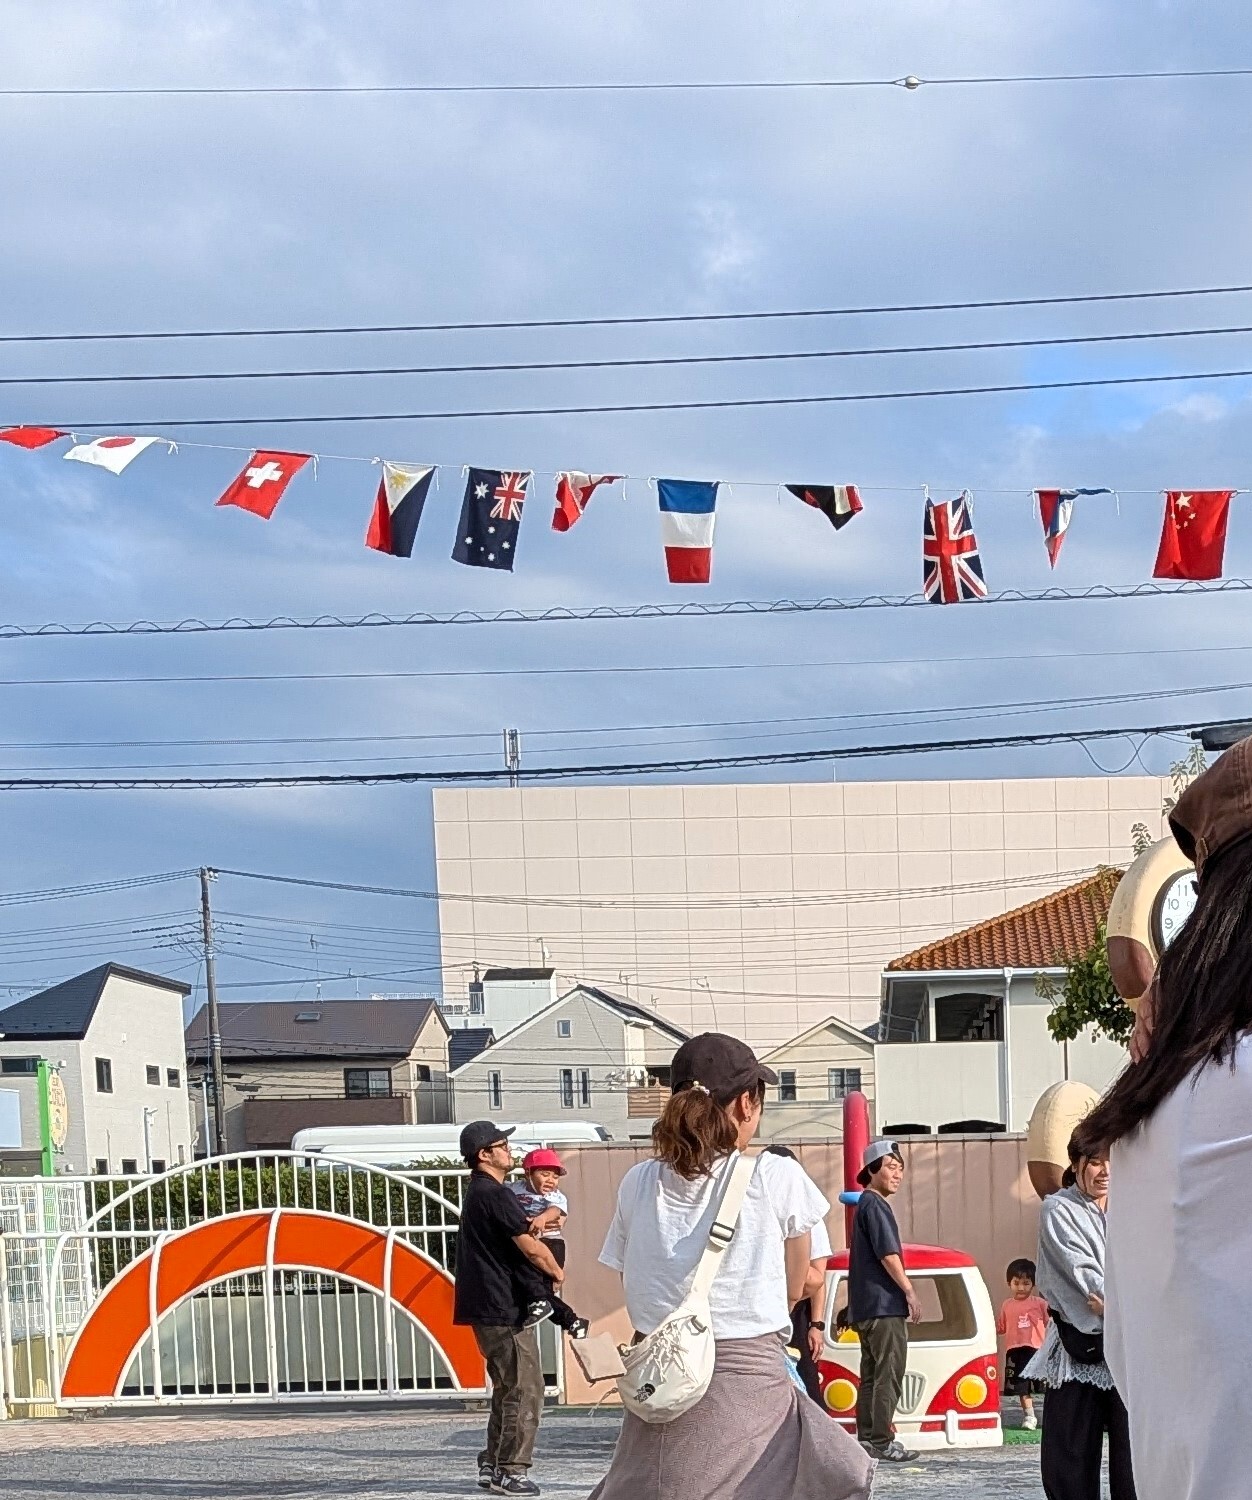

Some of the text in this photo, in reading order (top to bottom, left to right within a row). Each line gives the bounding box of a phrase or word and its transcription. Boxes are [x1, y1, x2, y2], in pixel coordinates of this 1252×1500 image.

[1177, 884, 1188, 897] 11
[1167, 898, 1180, 910] 10
[1164, 917, 1174, 929] 9
